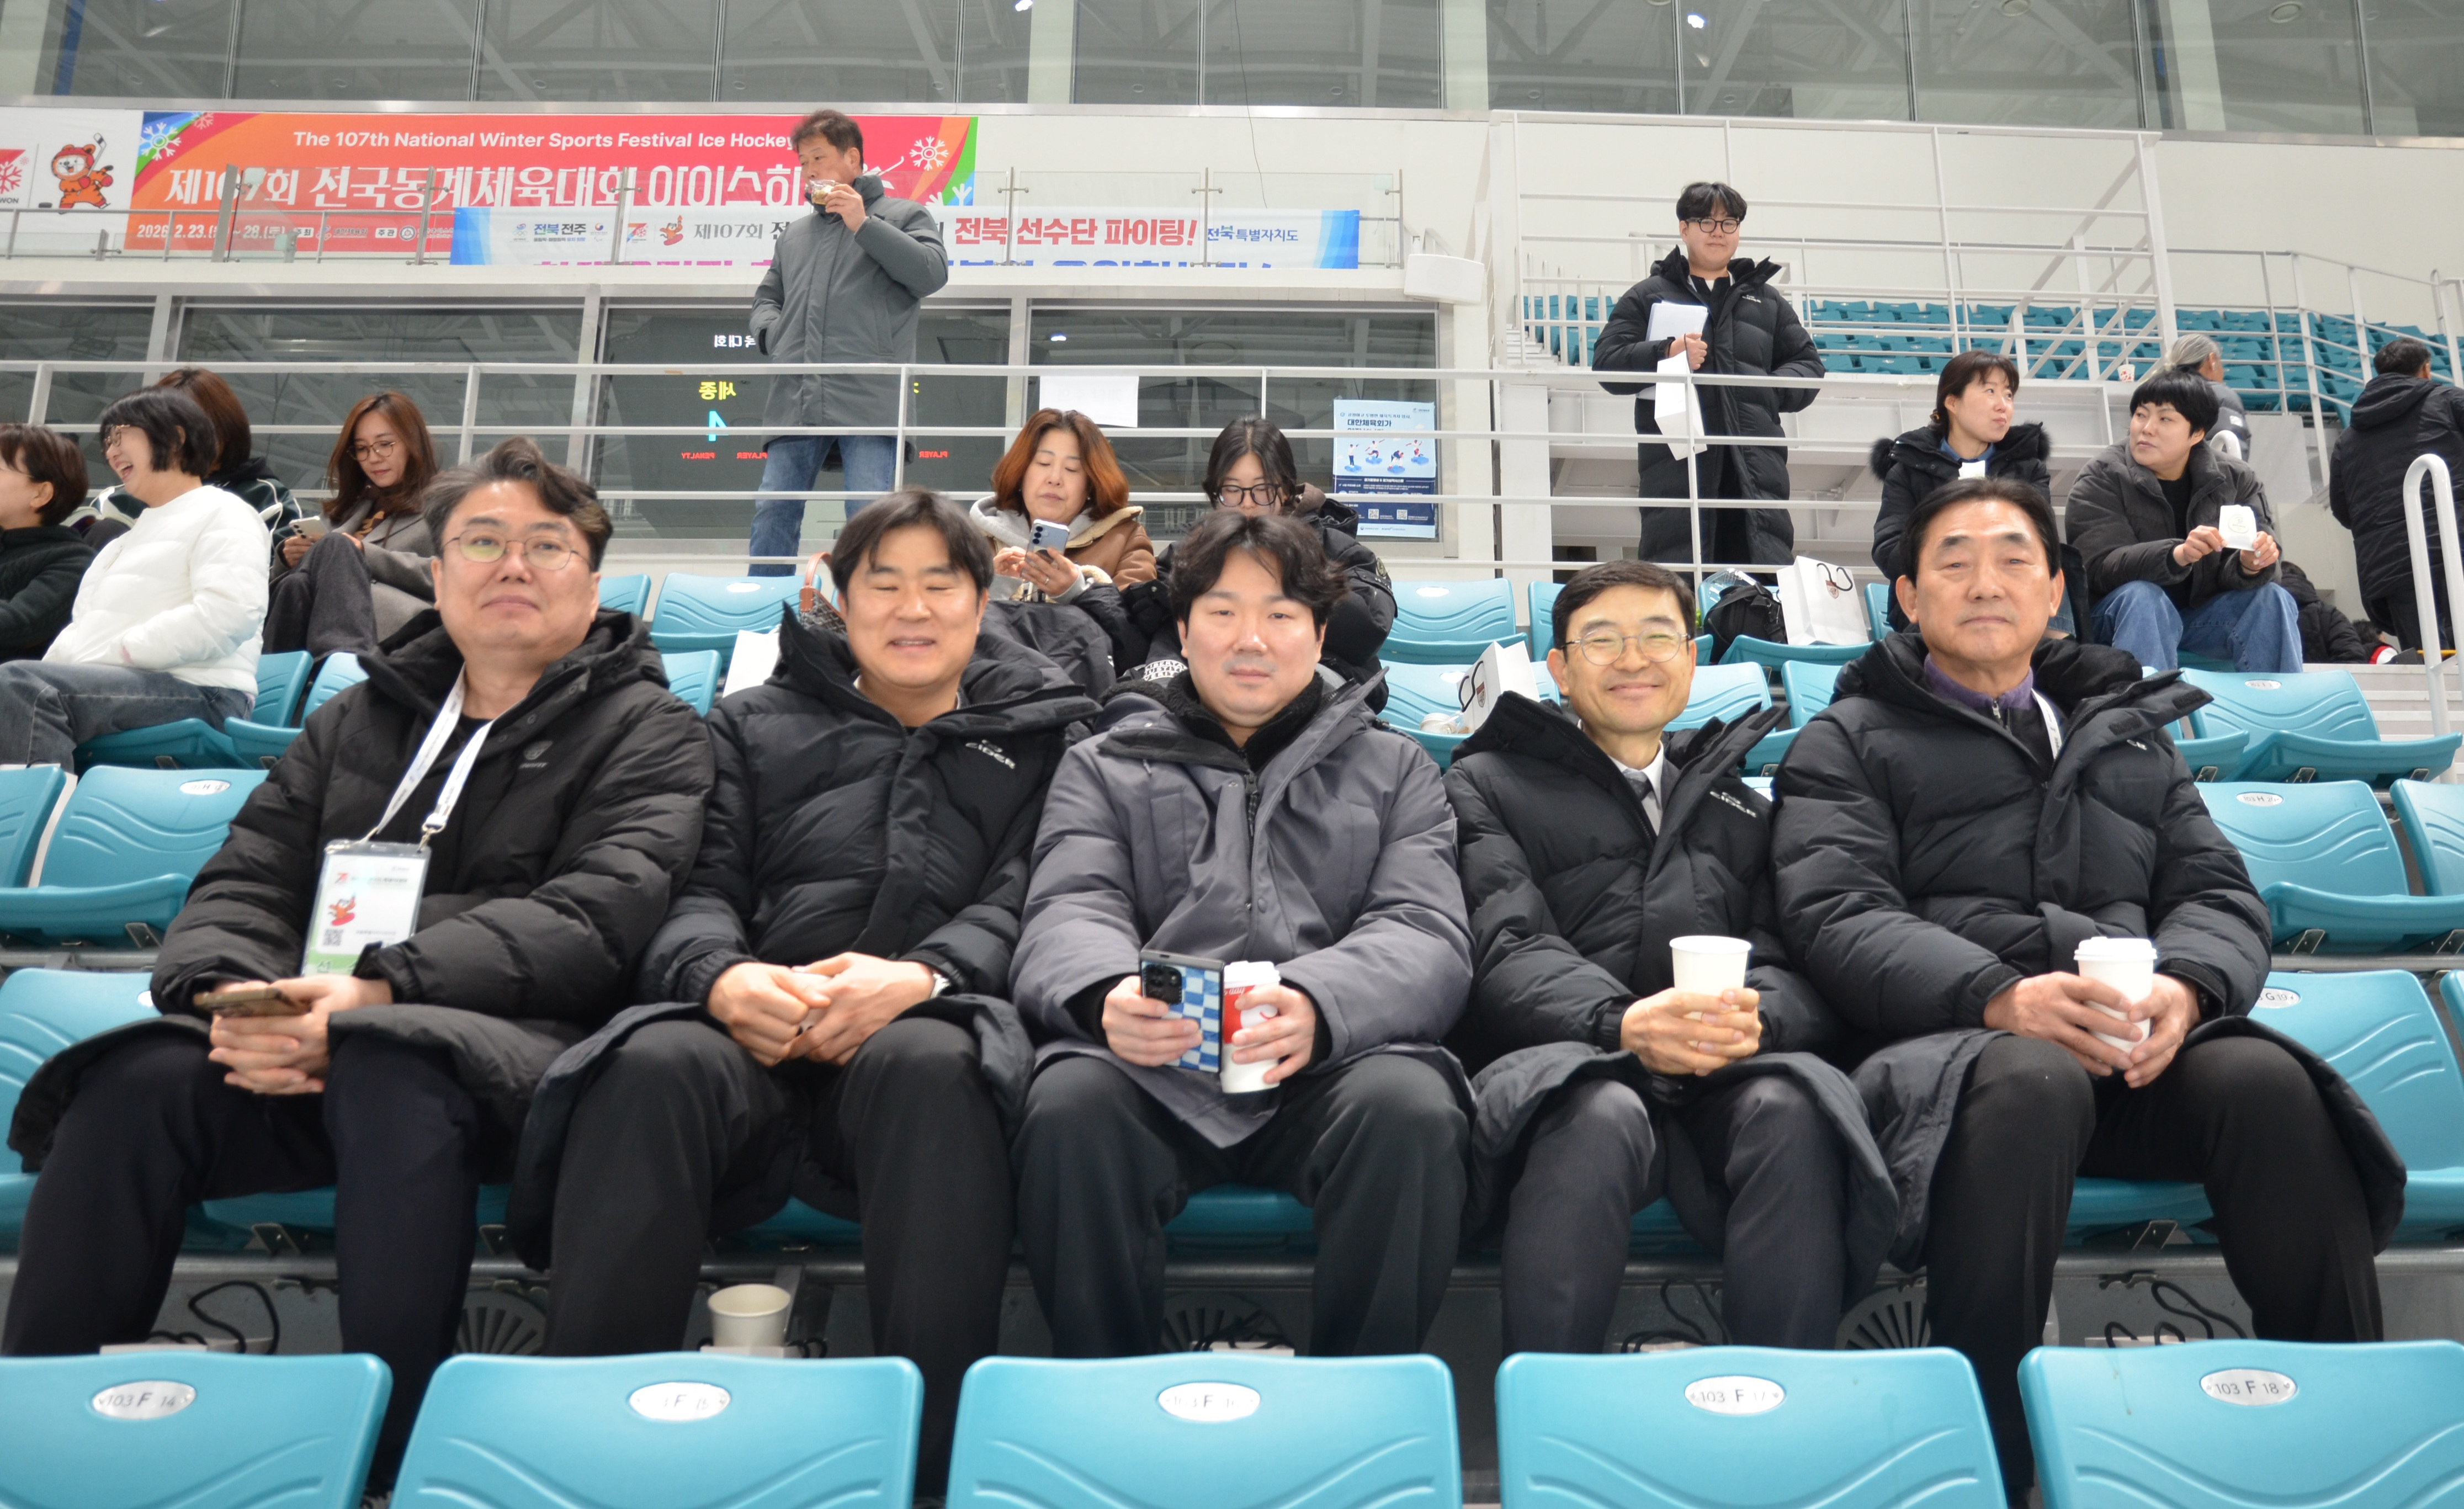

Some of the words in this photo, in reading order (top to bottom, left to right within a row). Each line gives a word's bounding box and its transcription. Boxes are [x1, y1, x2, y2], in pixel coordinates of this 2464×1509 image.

[294, 132, 330, 146] The
[335, 132, 390, 146] 107th
[400, 132, 474, 147] National
[479, 132, 545, 147] Winter
[549, 132, 613, 150] Sports
[618, 132, 692, 147] Festival
[698, 133, 725, 147] Ice
[309, 165, 637, 209] 전국동계체육대회
[647, 164, 811, 208] 아이스하
[534, 224, 559, 235] 전북
[561, 224, 586, 235] 전주
[694, 223, 763, 240] 제107회
[955, 217, 1008, 245] 전북
[1017, 217, 1098, 245] 선수단
[1104, 218, 1197, 247] 파이팅!
[1347, 419, 1392, 427] 대한체육회가
[2265, 992, 2275, 1001] G
[2215, 1383, 2240, 1395] 103
[2245, 1380, 2256, 1395] F
[2263, 1383, 2279, 1395] 18
[107, 1395, 135, 1407] 103
[136, 1392, 153, 1407] F
[160, 1396, 177, 1407] 14
[674, 1394, 688, 1407] F
[1203, 1394, 1214, 1408] F
[1701, 1391, 1725, 1403] 103
[1735, 1389, 1744, 1402] F
